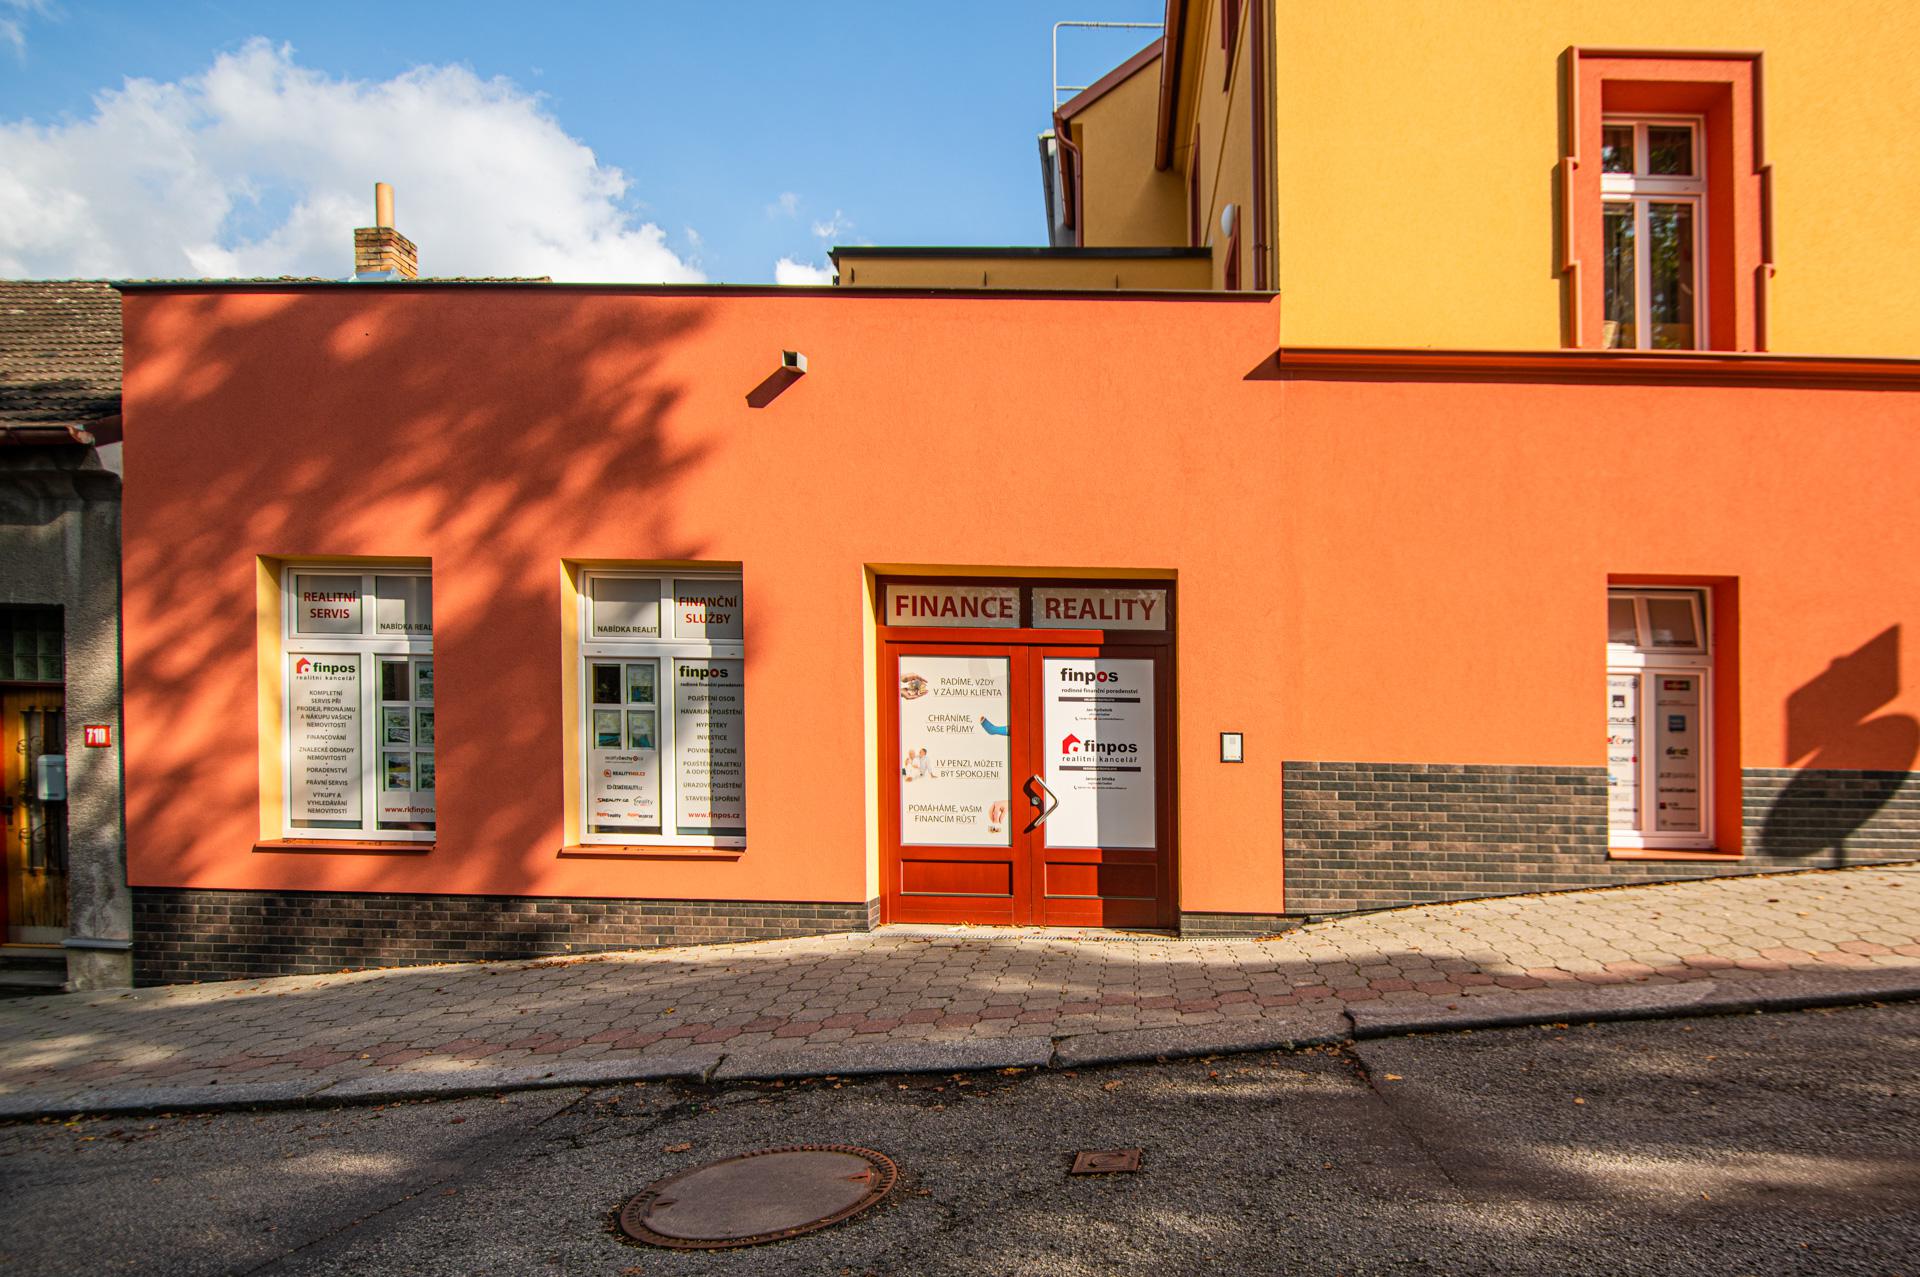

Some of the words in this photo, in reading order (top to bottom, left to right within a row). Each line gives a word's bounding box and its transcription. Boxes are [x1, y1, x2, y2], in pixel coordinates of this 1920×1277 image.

[304, 590, 356, 603] REALITNÍ
[679, 595, 737, 608] FINANČNÍ
[896, 595, 1013, 619] FINANCE
[1045, 598, 1157, 621] REALITY
[310, 608, 350, 619] SERVIS
[685, 612, 731, 624] SLUŽBY
[380, 622, 413, 630] NABÍDKA
[597, 625, 631, 633] NABÍDKA
[313, 662, 356, 675] finpos
[679, 666, 728, 680] finpos
[940, 677, 973, 686] RADÍME,
[975, 678, 995, 686] VŽDY
[1060, 668, 1118, 685] finpos
[933, 688, 939, 696] V
[940, 687, 968, 696] ZÁJMU
[970, 688, 1002, 697] KLIENTA
[928, 713, 972, 723] CHRÁNÍME,
[927, 725, 944, 733] VAŠE
[946, 724, 974, 733] PŘÍJMY
[1084, 740, 1138, 755] finpos
[947, 760, 972, 768] PENZI,
[973, 759, 1003, 767] MŮŽETE
[940, 769, 954, 777] BÝT
[956, 770, 999, 778] SPOKOJENI
[908, 803, 958, 812] POMÁHÁME,
[960, 804, 982, 812] VAŠIM
[914, 813, 955, 823] FINANCÍM
[956, 813, 976, 823] RŮST
